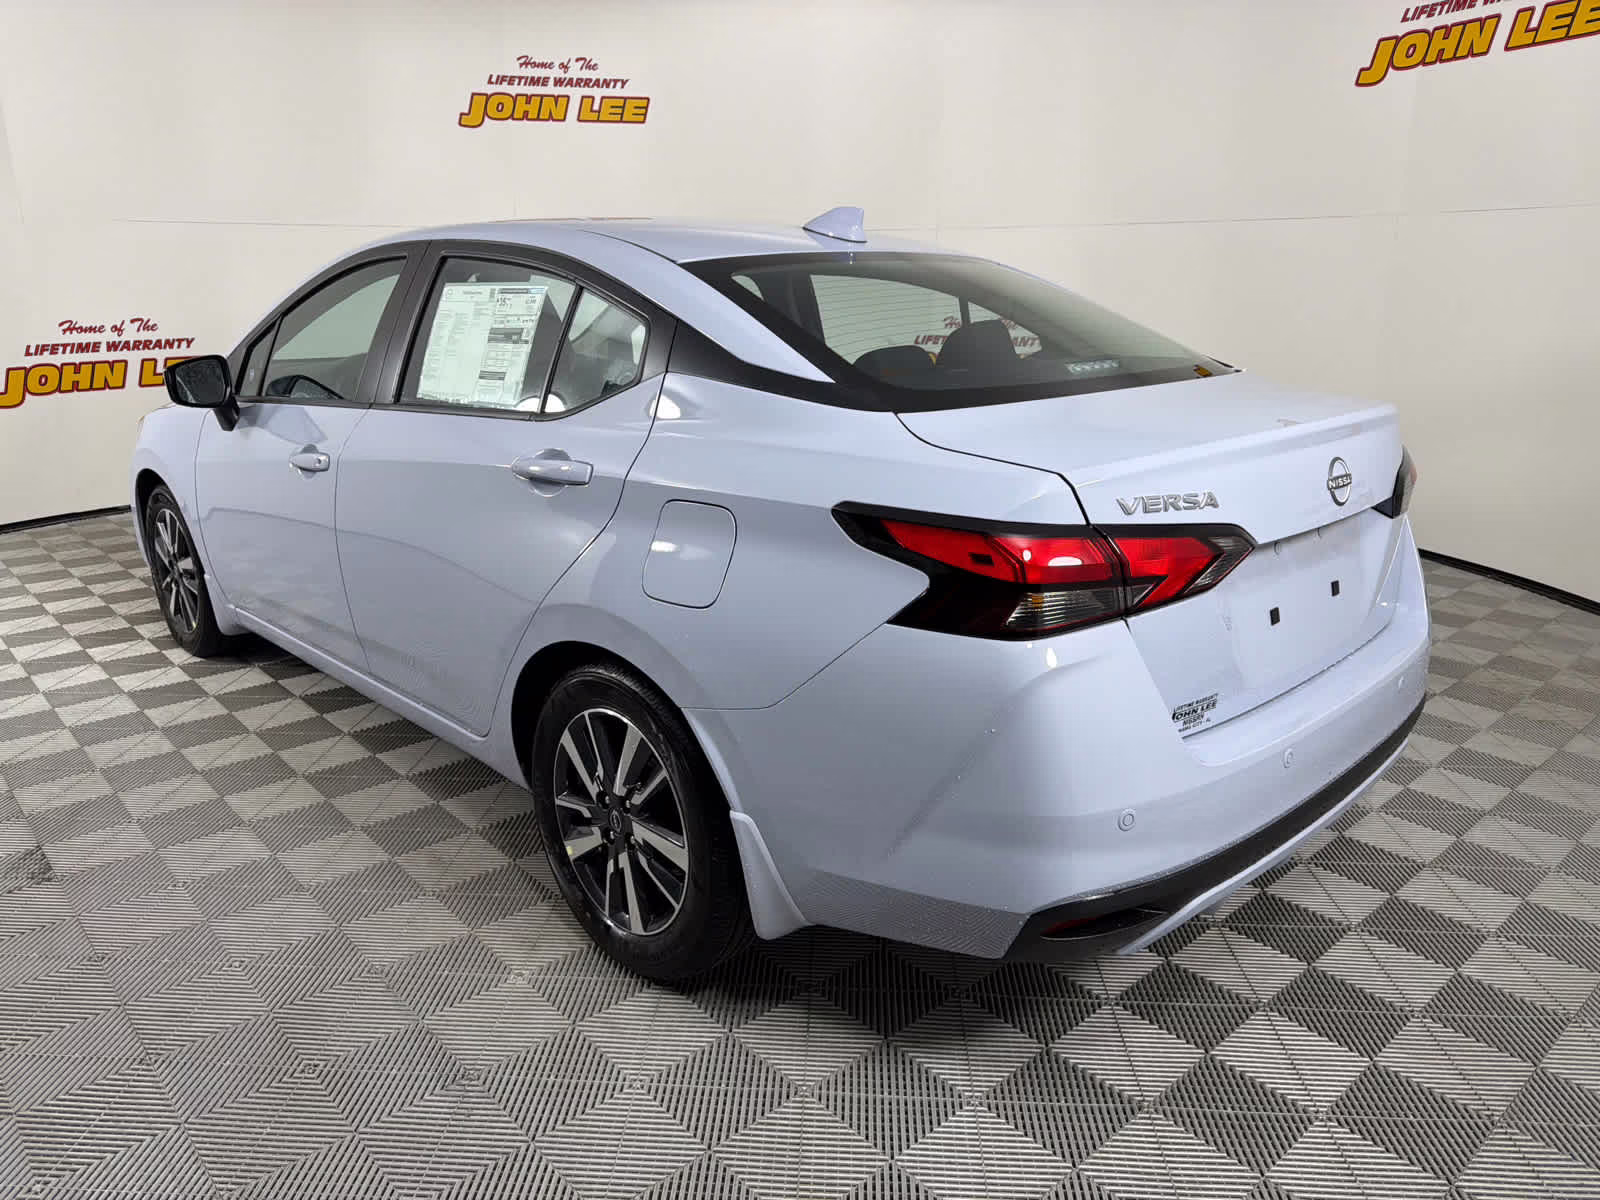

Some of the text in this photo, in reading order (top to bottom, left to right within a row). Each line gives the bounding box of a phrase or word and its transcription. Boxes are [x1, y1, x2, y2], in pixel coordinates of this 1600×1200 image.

[1354, 0, 1600, 87] JOHN LEE
[516, 55, 599, 73] Home of The
[487, 74, 630, 89] LIFETIME WARRANTY
[458, 92, 650, 128] JOHN LEE
[58, 318, 158, 336] Home of The
[24, 337, 196, 357] LIFETIME WARRANTY
[914, 335, 948, 345] LIFET
[0, 360, 127, 409] JOHN
[1116, 491, 1220, 516] VERSA
